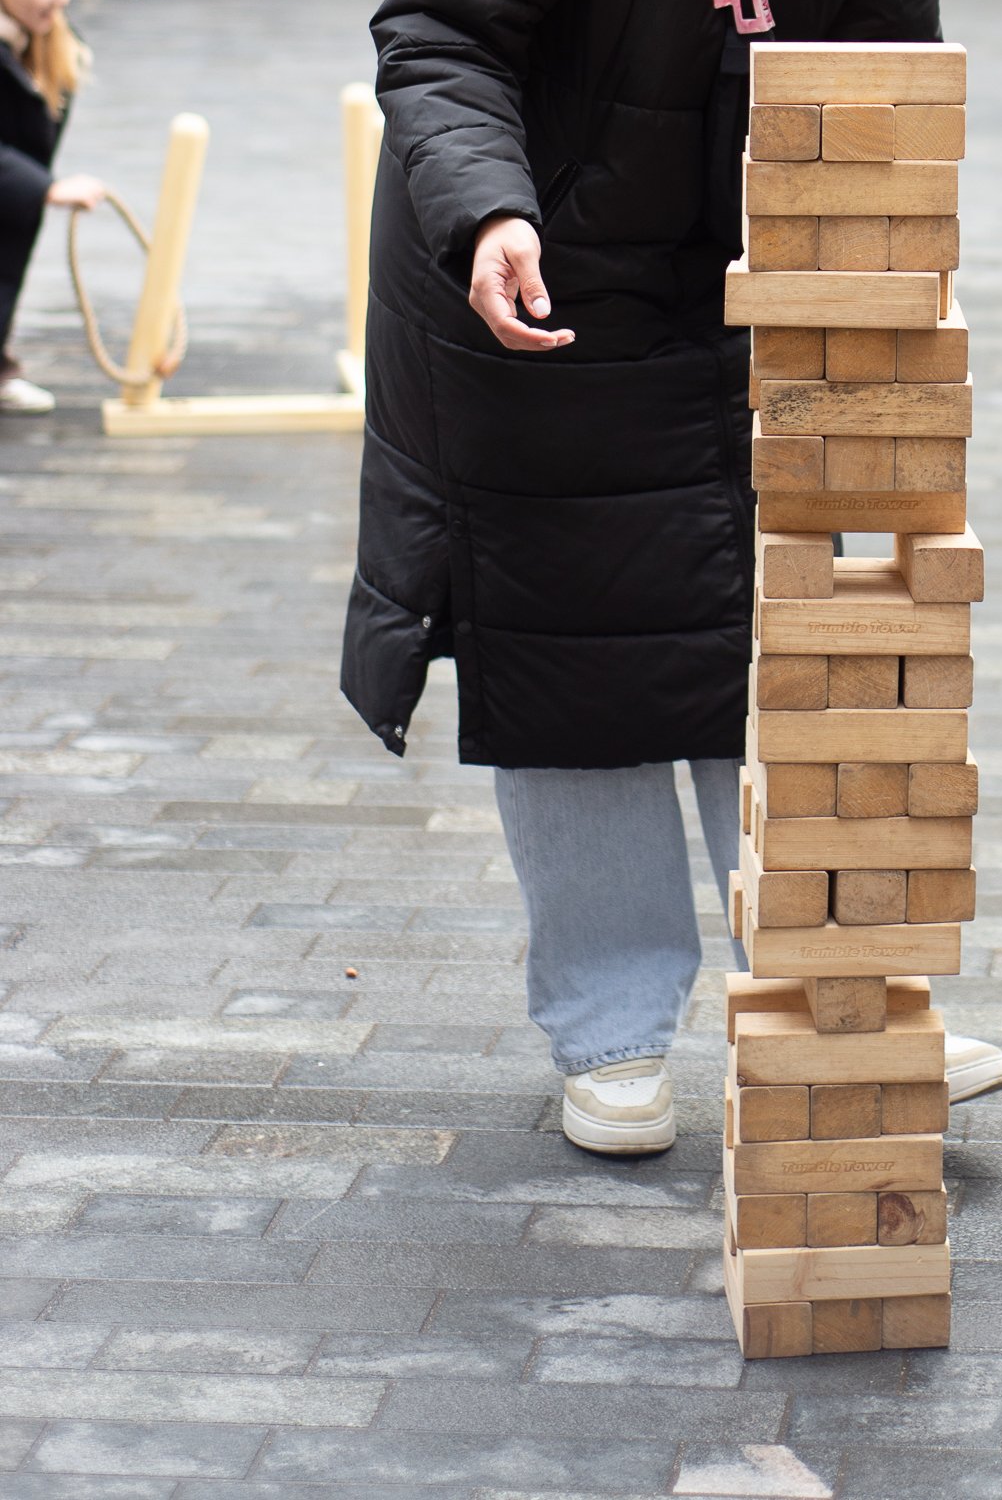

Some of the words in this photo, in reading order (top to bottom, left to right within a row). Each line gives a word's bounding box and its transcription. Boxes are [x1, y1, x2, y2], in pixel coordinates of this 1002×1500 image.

[806, 498, 866, 510] Tumble
[867, 498, 919, 510] Tower
[808, 622, 867, 634] Tumble
[870, 621, 921, 634] Tower
[801, 946, 859, 958] Tumble
[862, 945, 913, 957] Tower
[844, 1160, 895, 1172] Tower
